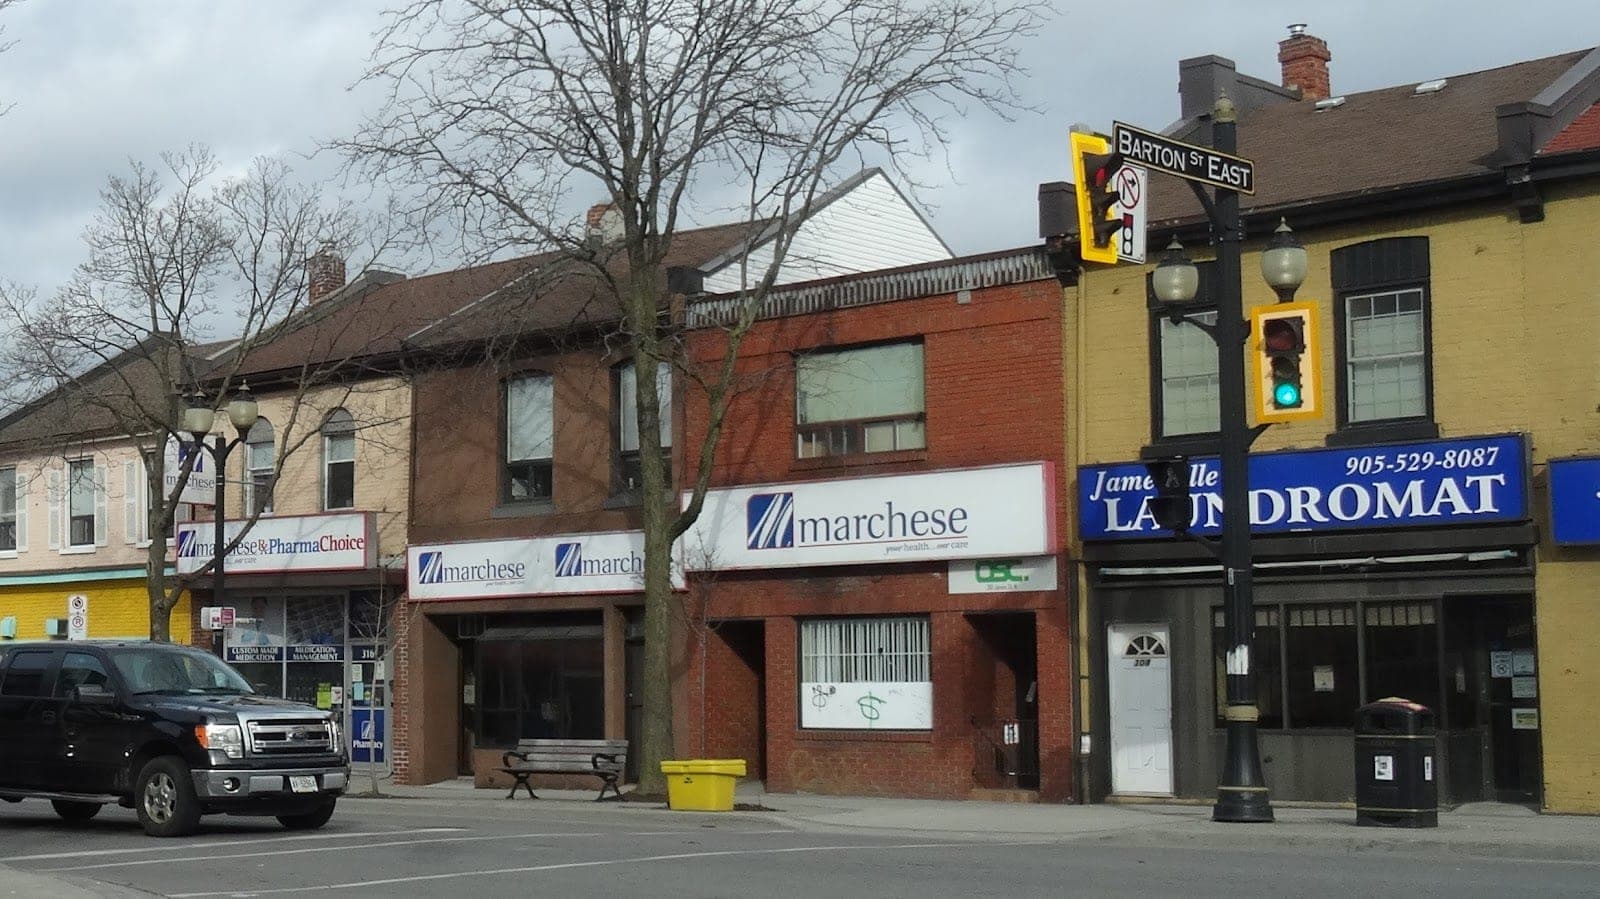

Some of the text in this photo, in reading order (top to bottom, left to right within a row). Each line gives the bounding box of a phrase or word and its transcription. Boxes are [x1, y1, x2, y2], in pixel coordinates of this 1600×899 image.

[1119, 129, 1186, 172] BARTON
[1208, 155, 1251, 187] EAST
[1346, 447, 1500, 476] 905-529-8087
[1089, 463, 1218, 501] Jamelle
[798, 501, 968, 543] marchese
[195, 537, 258, 556] mahese
[268, 534, 364, 555] PharmaChoice
[950, 541, 969, 550] care
[444, 558, 525, 581] marchese
[583, 551, 644, 574] march
[231, 647, 260, 655] CUSTOM
[352, 739, 383, 750] Pharmcy
